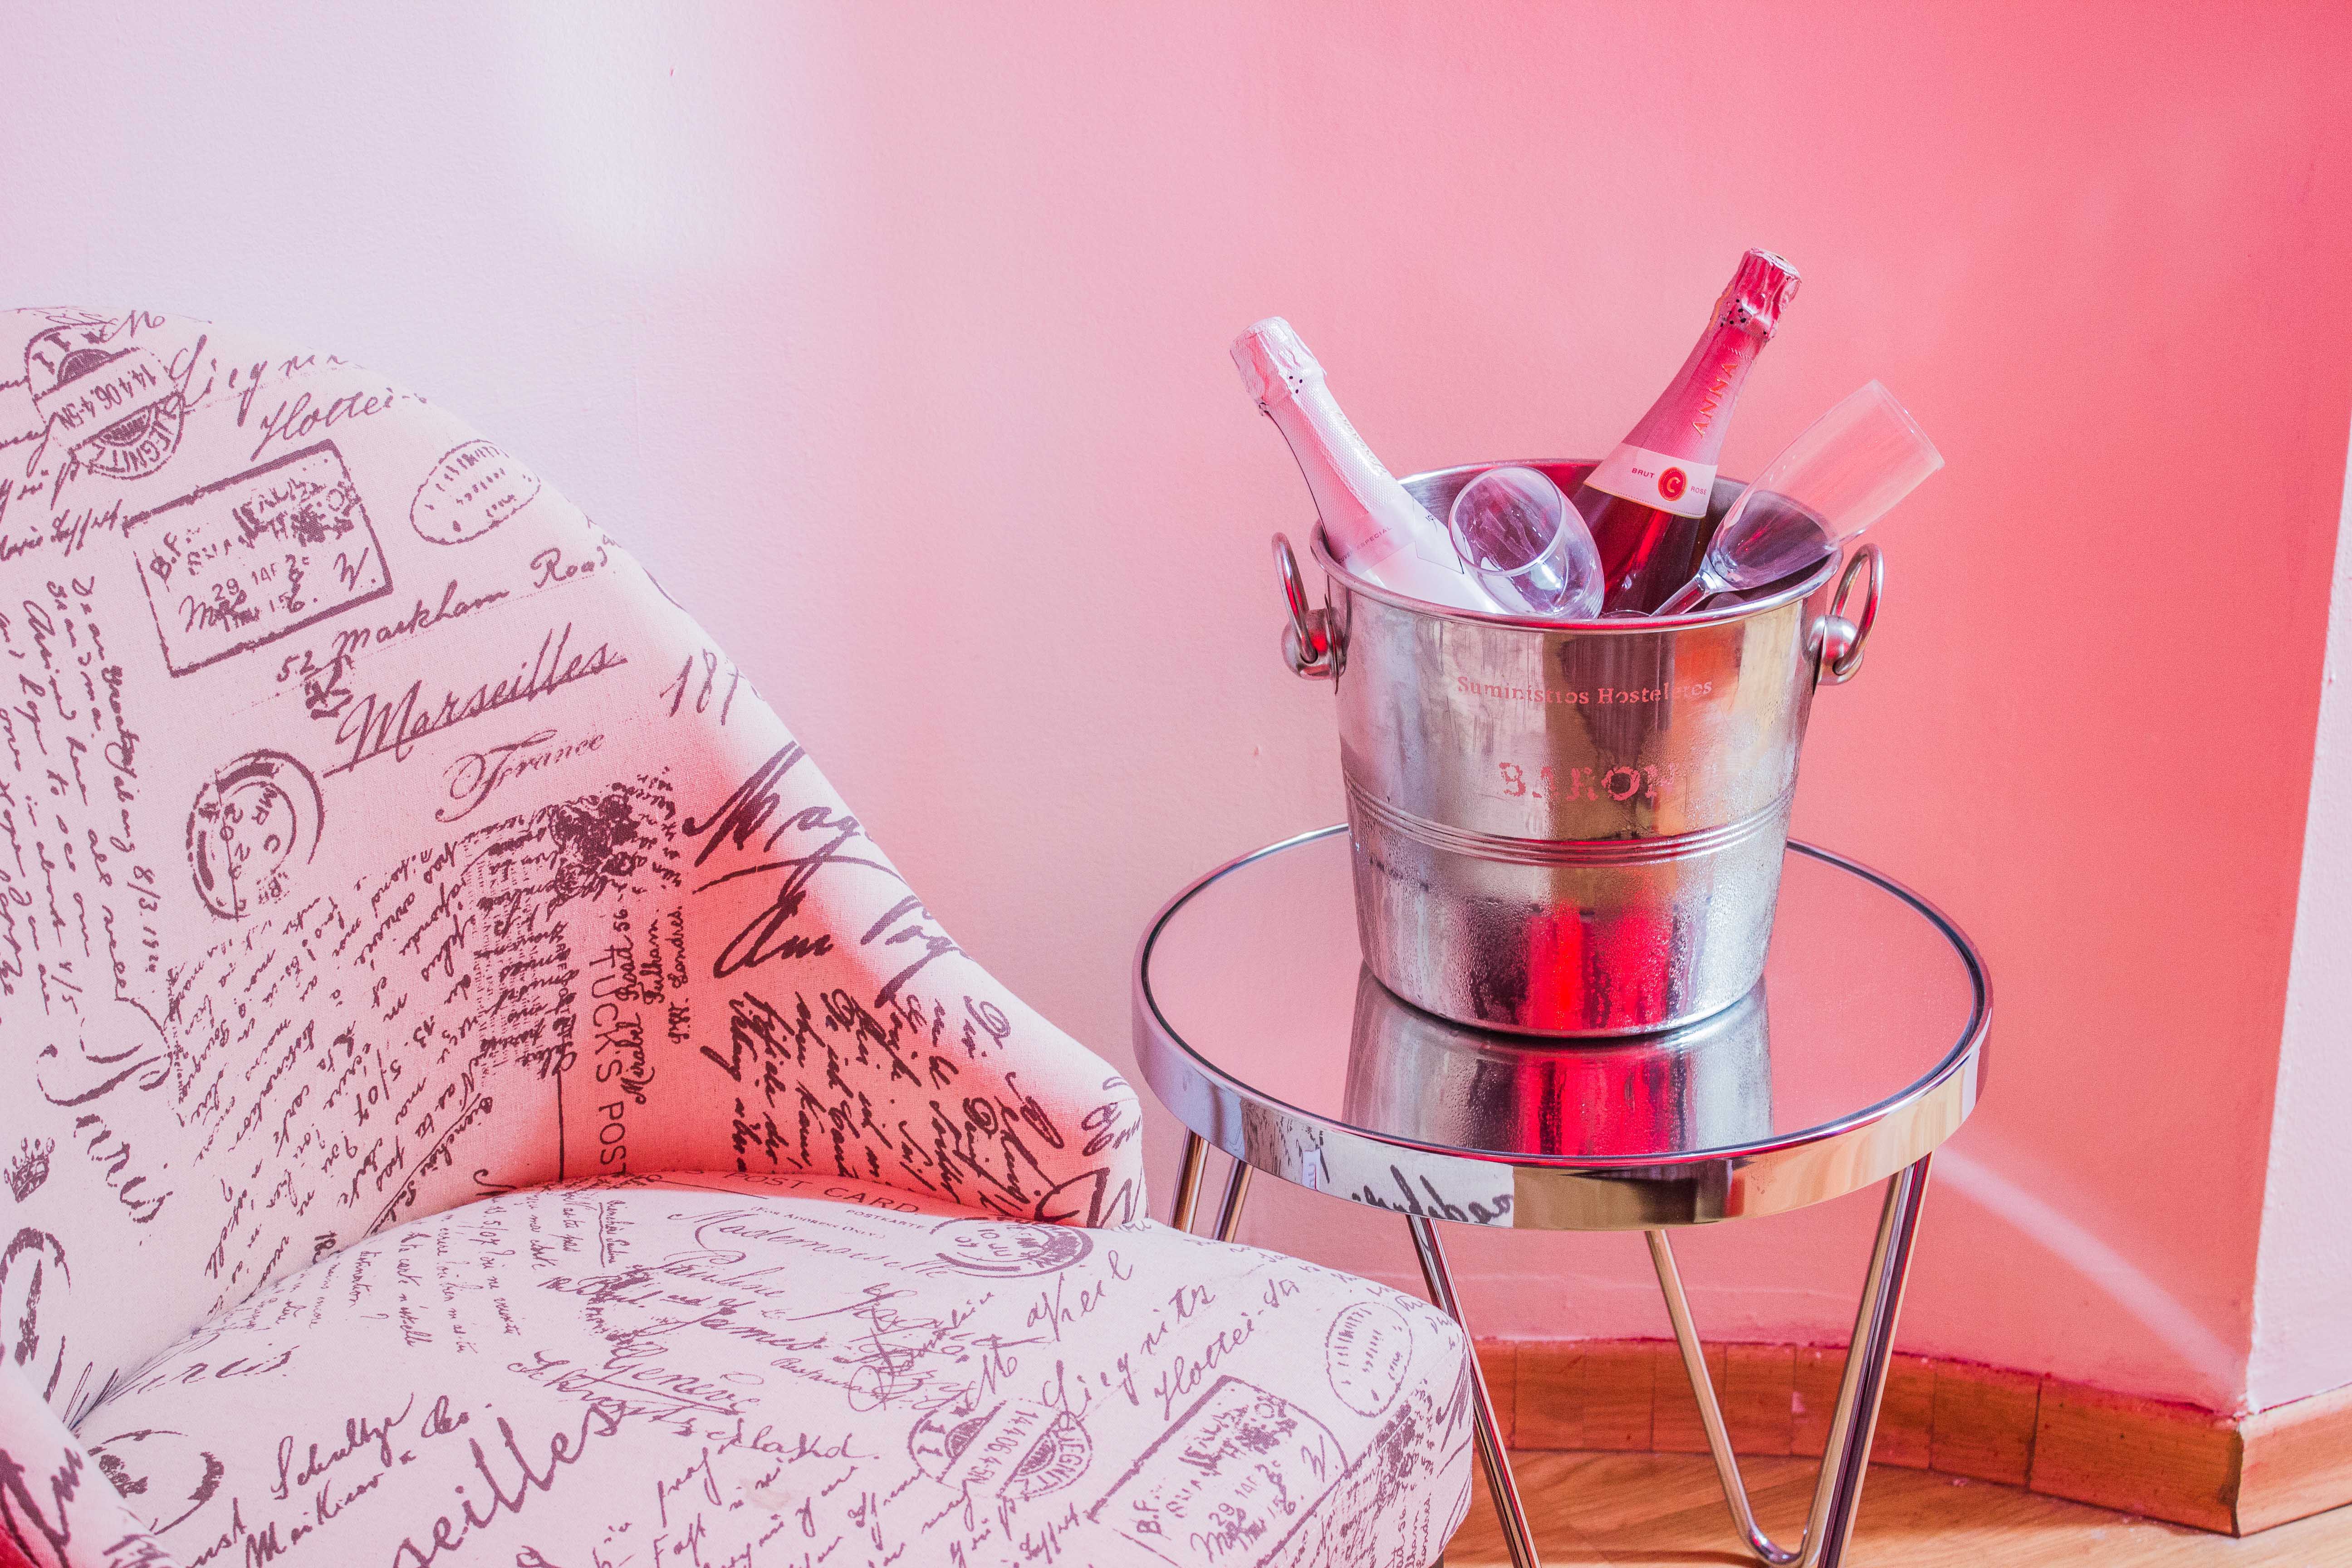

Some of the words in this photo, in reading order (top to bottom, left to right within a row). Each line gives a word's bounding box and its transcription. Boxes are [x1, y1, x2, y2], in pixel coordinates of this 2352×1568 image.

[1692, 362, 1739, 439] ANNA
[1631, 467, 1655, 479] BRUT
[334, 622, 624, 772] Marseilles
